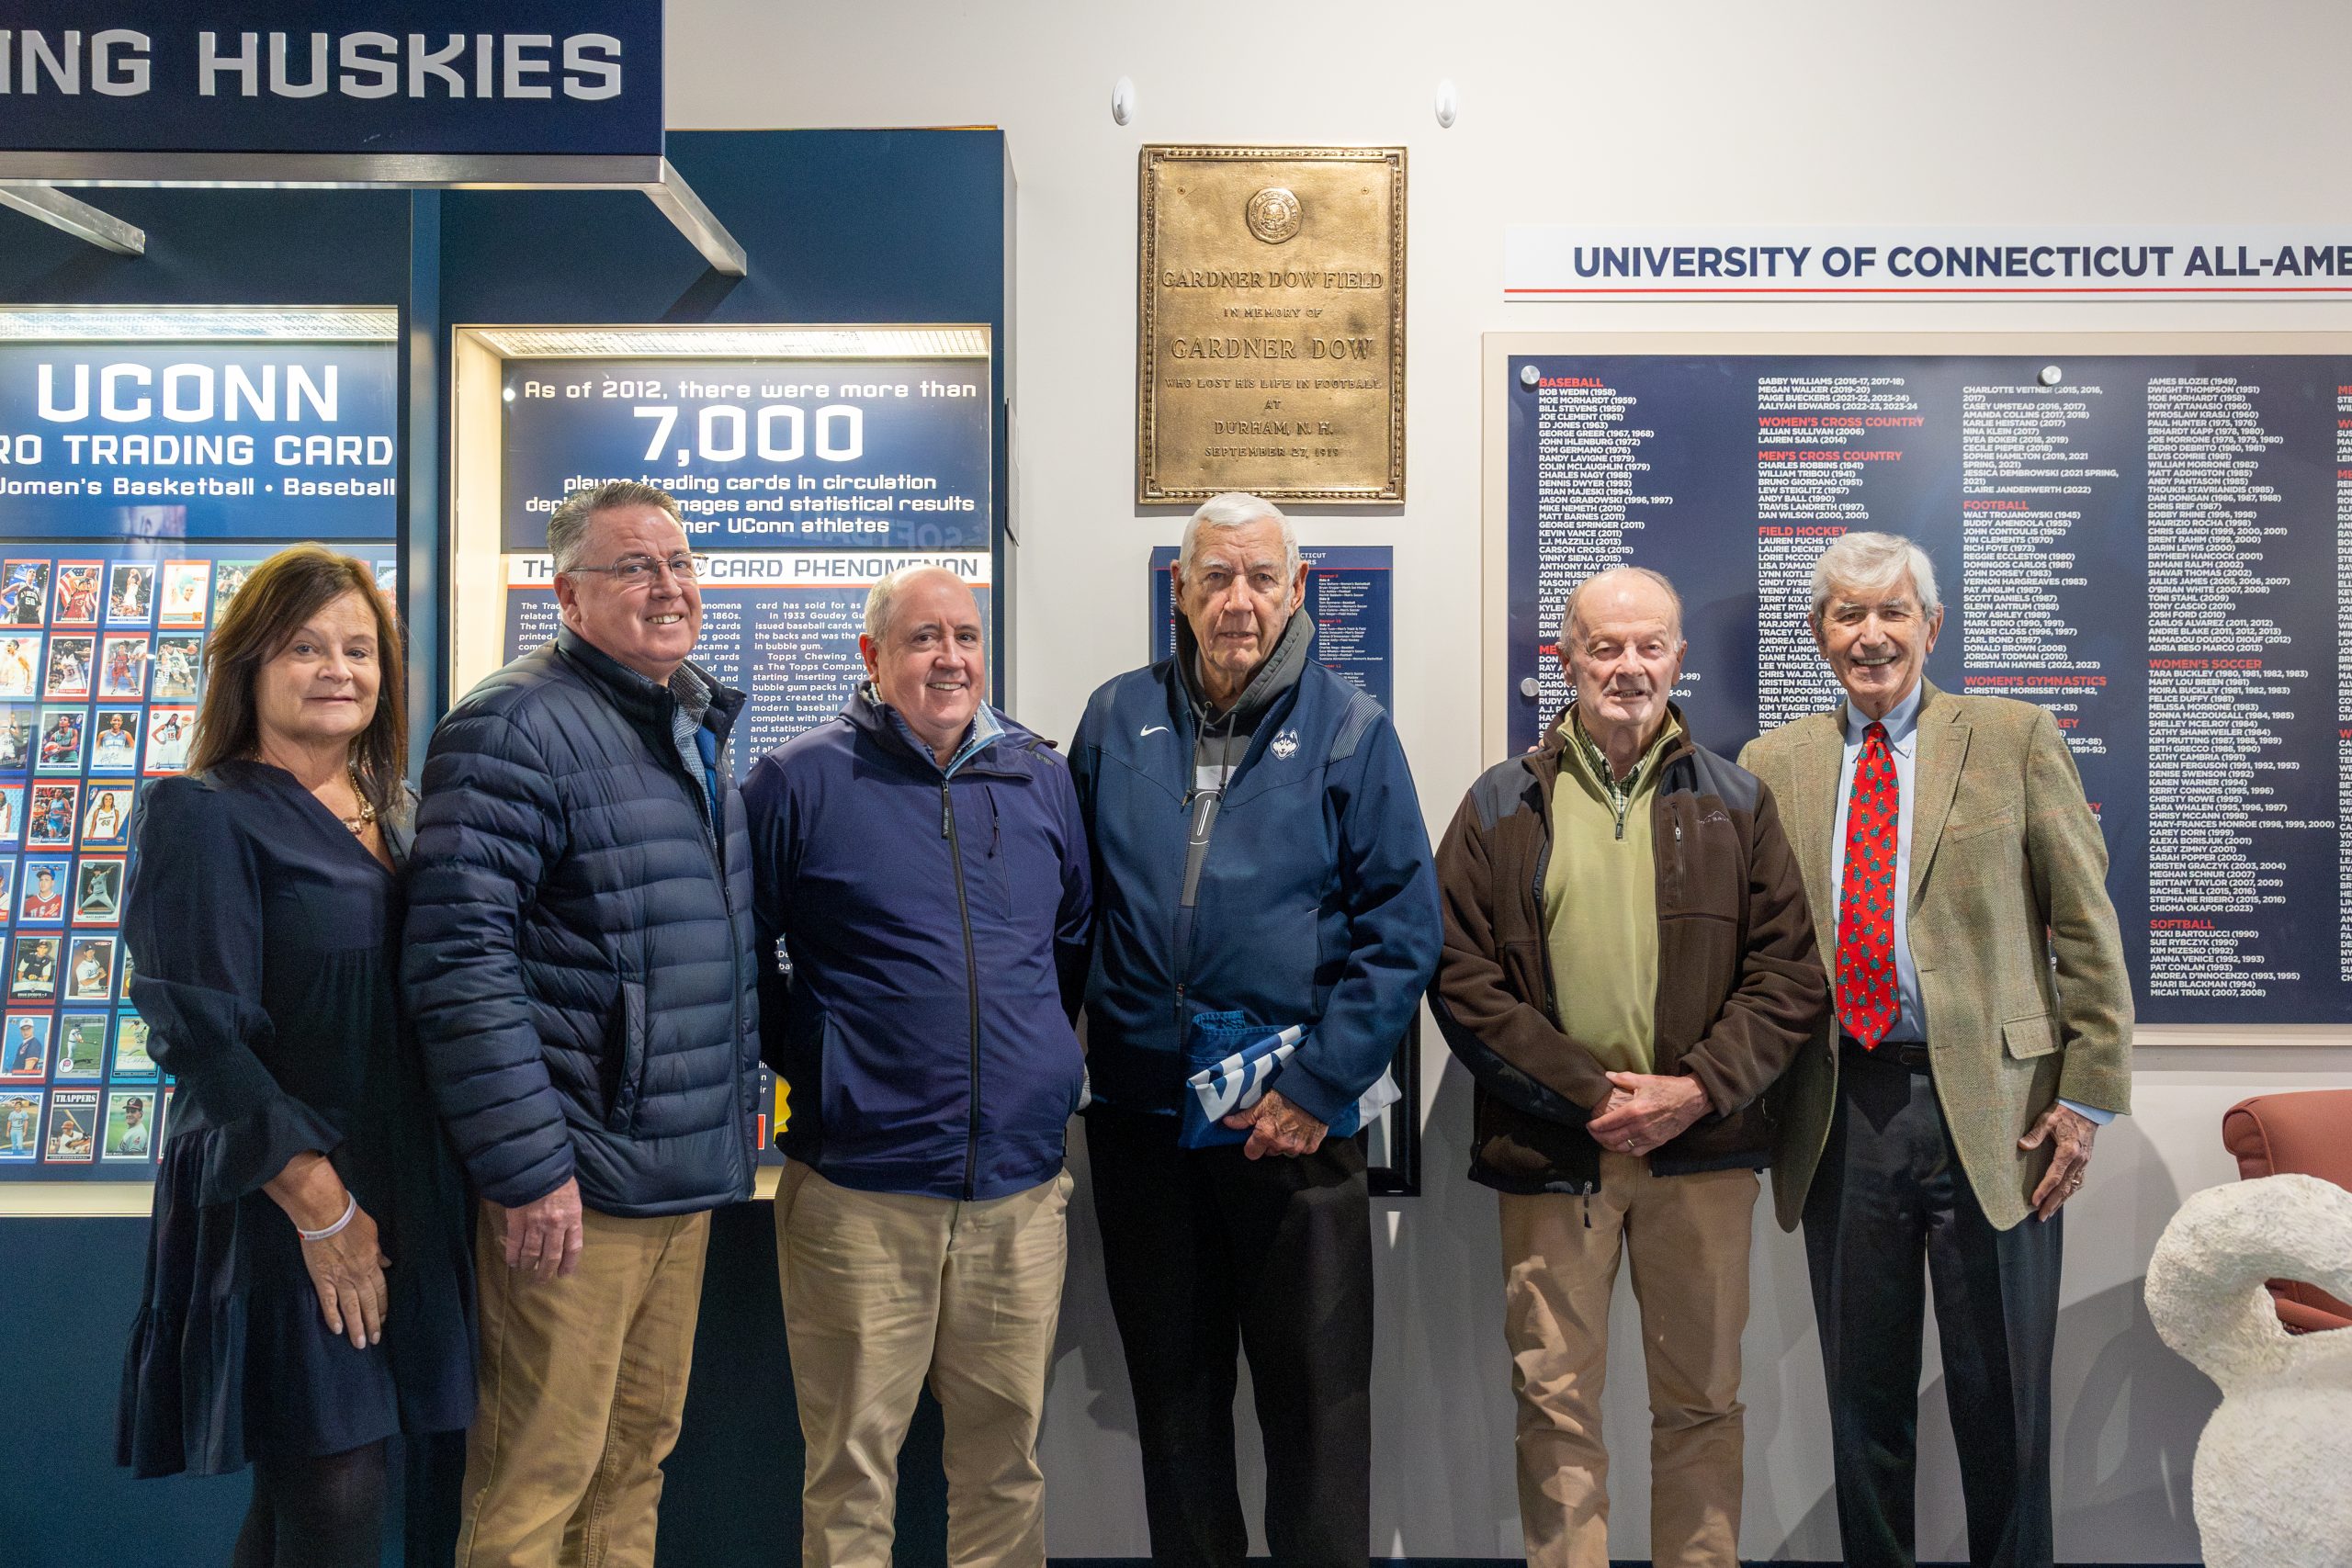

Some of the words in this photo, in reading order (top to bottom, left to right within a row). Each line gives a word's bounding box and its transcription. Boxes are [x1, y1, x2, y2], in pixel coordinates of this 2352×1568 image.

[199, 32, 621, 100] HUSKIES
[1575, 247, 1811, 276] UNIVERSITY
[1823, 247, 1876, 276] OF
[1888, 246, 2173, 276] CONNECTICUT
[2184, 246, 2352, 276] ALL-AME
[1162, 272, 1262, 288] GARDNER
[1270, 271, 1318, 288] DOW
[1324, 272, 1384, 289] FIELD
[1224, 308, 1238, 318] IN
[1244, 308, 1300, 318] MEMORY
[1306, 308, 1323, 318] OF
[1171, 338, 1296, 359] GARDNER
[1312, 338, 1374, 359] DOW
[39, 354, 337, 423] UCONN
[1165, 378, 1192, 388] WHO
[1197, 378, 1231, 388] LOST
[1236, 378, 1255, 388] HIS
[1261, 378, 1291, 389] LIFE
[1296, 378, 1309, 389] IN
[1316, 378, 1382, 389] FOOTBALL
[1538, 378, 1602, 388] BASEBALL
[526, 382, 555, 398] As
[567, 382, 591, 398] of
[603, 381, 667, 400] 2012,
[678, 381, 751, 398] there
[762, 382, 829, 398] were
[841, 382, 908, 398] more
[920, 381, 976, 397] than
[1264, 399, 1281, 410] AT
[1758, 417, 1818, 426] WOMEN'S
[1821, 417, 1862, 426] CROSS
[1865, 417, 1924, 427] COUNTRY
[1216, 421, 1289, 435] DURHAM,
[1297, 421, 1311, 434] N.
[1318, 421, 1333, 434] H.
[634, 405, 863, 467] 7,000
[63, 434, 254, 465] TRADING
[275, 435, 392, 465] CARD
[1205, 447, 1285, 457] SEPTEMBER
[1758, 451, 1796, 461] MEN'S
[1798, 451, 1841, 461] CROSS
[1843, 451, 1902, 461] COUNTRY
[0, 478, 101, 494] omen's
[114, 478, 254, 495] Basketball
[284, 479, 394, 495] Baseball
[640, 475, 718, 494] trading
[727, 475, 790, 490] cards
[798, 475, 815, 489] in
[823, 475, 935, 490] circulation
[681, 499, 739, 515] mages
[746, 497, 783, 511] and
[790, 496, 892, 511] statistical
[899, 496, 974, 511] results
[1963, 500, 2029, 511] FOOTBALL
[729, 518, 794, 533] UConn
[802, 518, 888, 532] athletes
[1758, 526, 1793, 536] FIELD
[1796, 526, 1847, 536] HOCKEY
[523, 559, 553, 577] TH
[711, 559, 782, 577] CARD
[795, 558, 977, 577] PHENOMON
[810, 612, 846, 620] Goudey
[519, 633, 552, 641] printed
[768, 653, 797, 661] Topps
[2150, 660, 2209, 669] WOMEN'S
[2211, 659, 2262, 669] SOCCER
[1964, 676, 2024, 686] WOMEN'S
[2027, 676, 2107, 686] GYMNASTICS
[1810, 695, 1837, 704] (1994)
[2150, 919, 2215, 930] SOFTBALL
[55, 1094, 96, 1103] TRAPPERS
